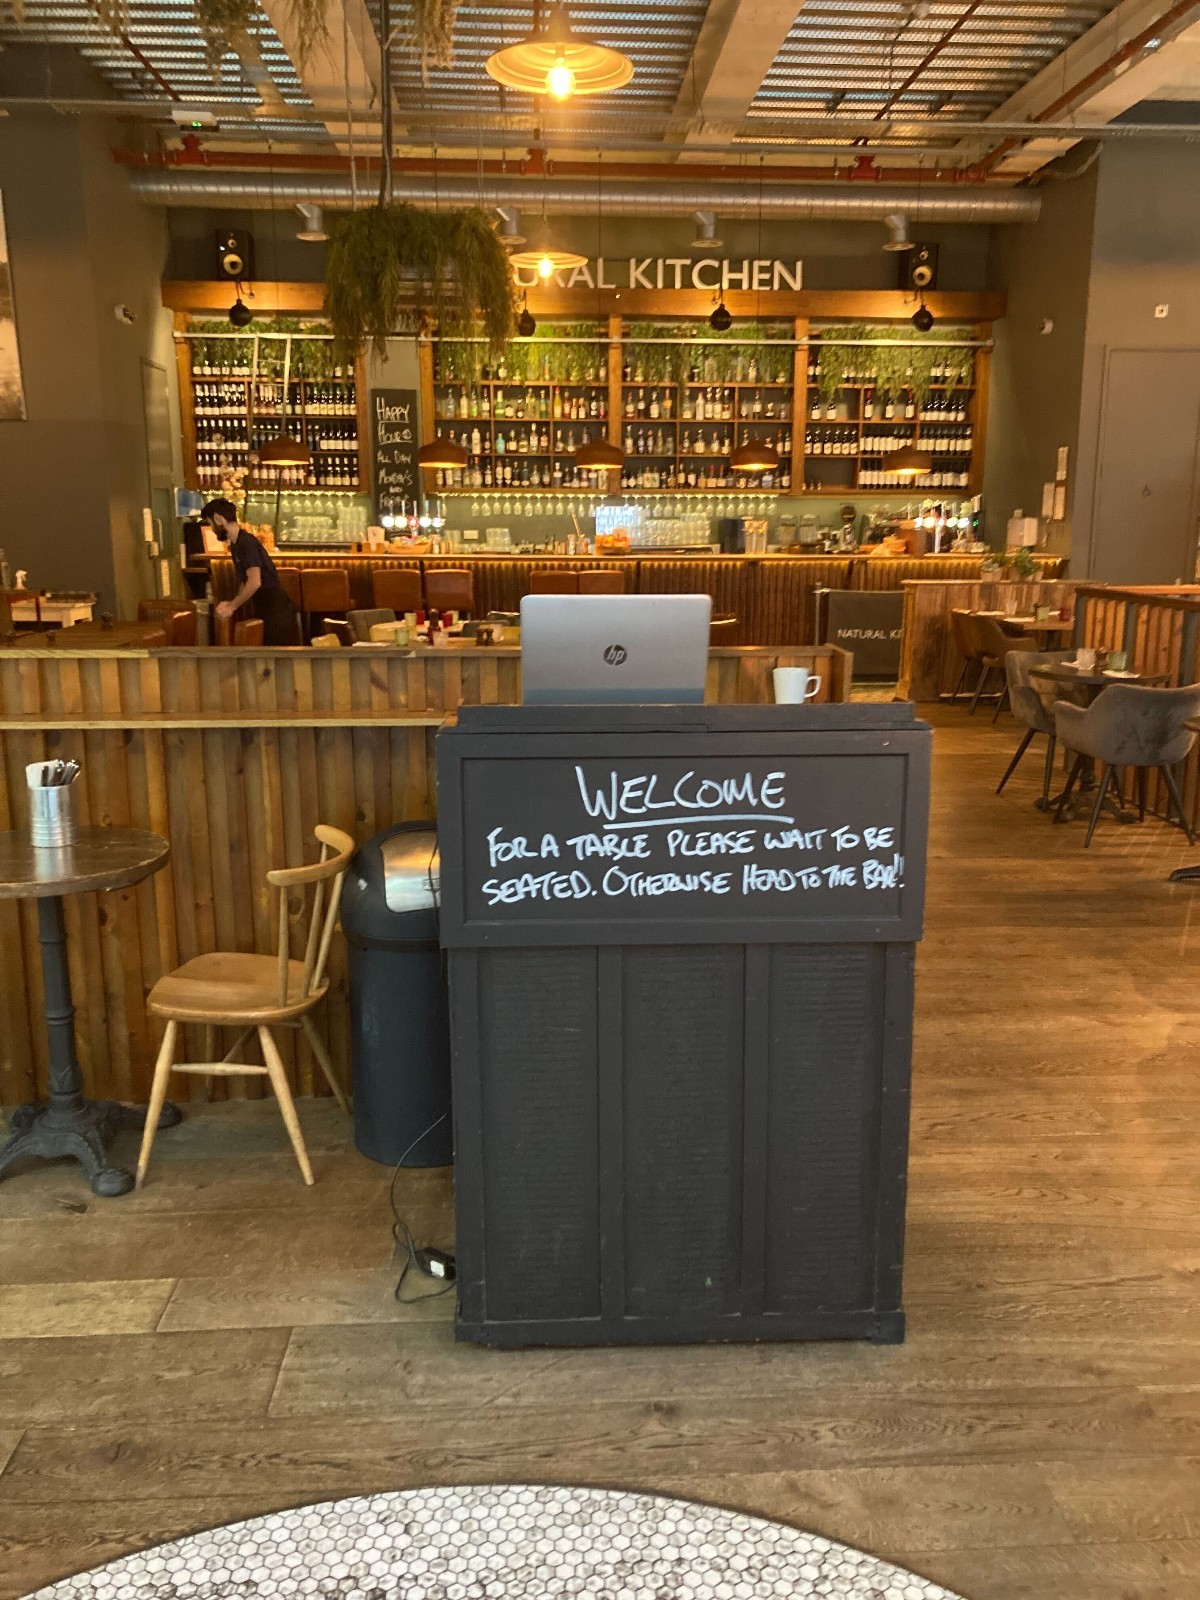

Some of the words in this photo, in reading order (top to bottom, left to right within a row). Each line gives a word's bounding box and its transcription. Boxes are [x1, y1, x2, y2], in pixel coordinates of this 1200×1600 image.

[630, 257, 804, 292] KITCHEN
[376, 396, 410, 421] HAPPY
[837, 628, 888, 640] NATURAL
[605, 645, 626, 666] hp
[574, 765, 787, 822] WELCOME
[487, 826, 537, 867] FOR
[539, 832, 561, 859] A
[566, 832, 652, 861] TABLE
[667, 828, 757, 858] PLEASE
[764, 827, 828, 850] WAIT
[830, 824, 859, 850] TO
[863, 826, 896, 851] BE
[481, 870, 597, 906] SEATED.
[602, 865, 731, 897] OTHERWISE
[742, 863, 796, 895] HEAD
[795, 867, 821, 889] TO
[821, 865, 858, 888] THE
